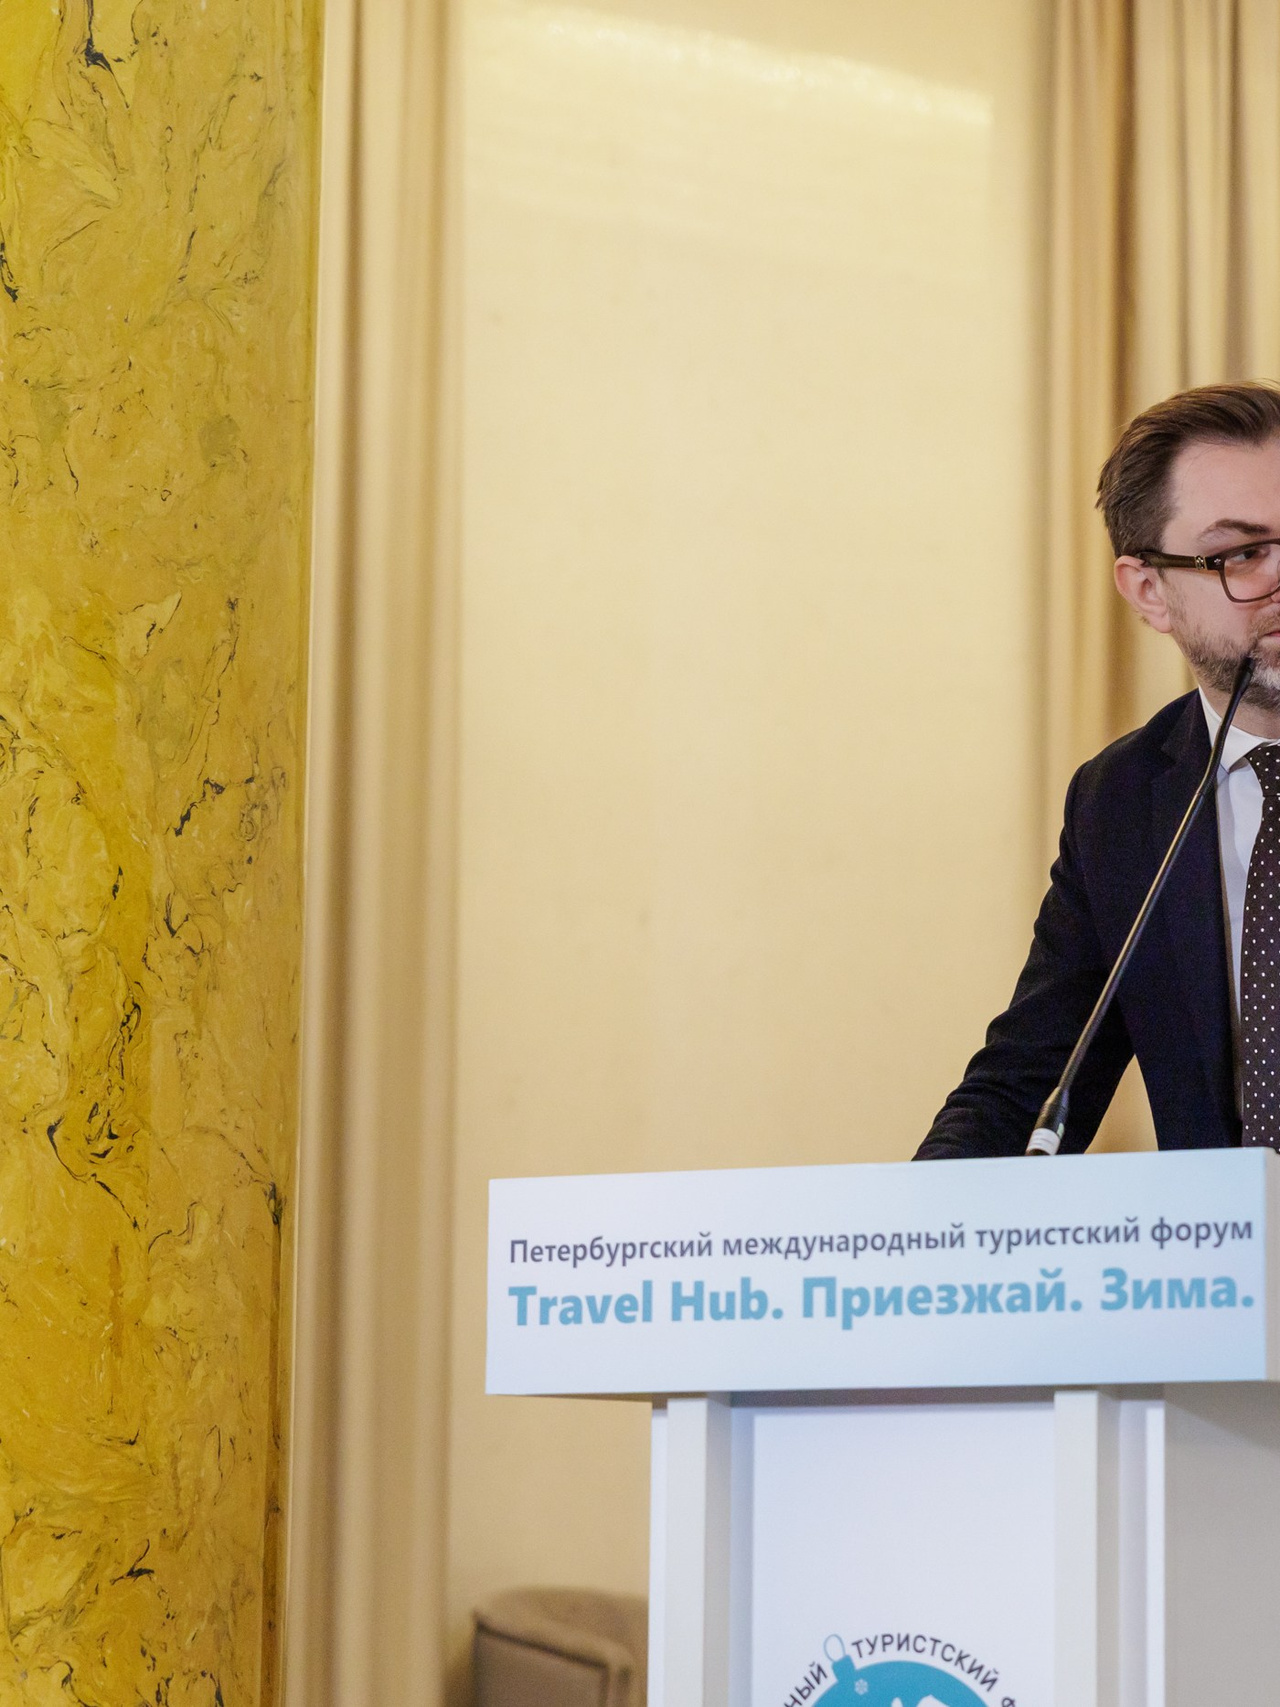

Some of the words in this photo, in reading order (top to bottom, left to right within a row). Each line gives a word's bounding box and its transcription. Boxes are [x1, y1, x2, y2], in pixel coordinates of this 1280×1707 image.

[509, 1231, 713, 1269] Петербургский
[722, 1221, 966, 1262] международный
[974, 1215, 1141, 1256] туристский
[1149, 1215, 1253, 1251] форум
[507, 1279, 653, 1327] Travel
[670, 1276, 784, 1322] Hub.
[802, 1267, 1083, 1331] Приезжай.
[1100, 1267, 1255, 1312] Зима.
[850, 1632, 999, 1693] ТУРИСТСКИЙ
